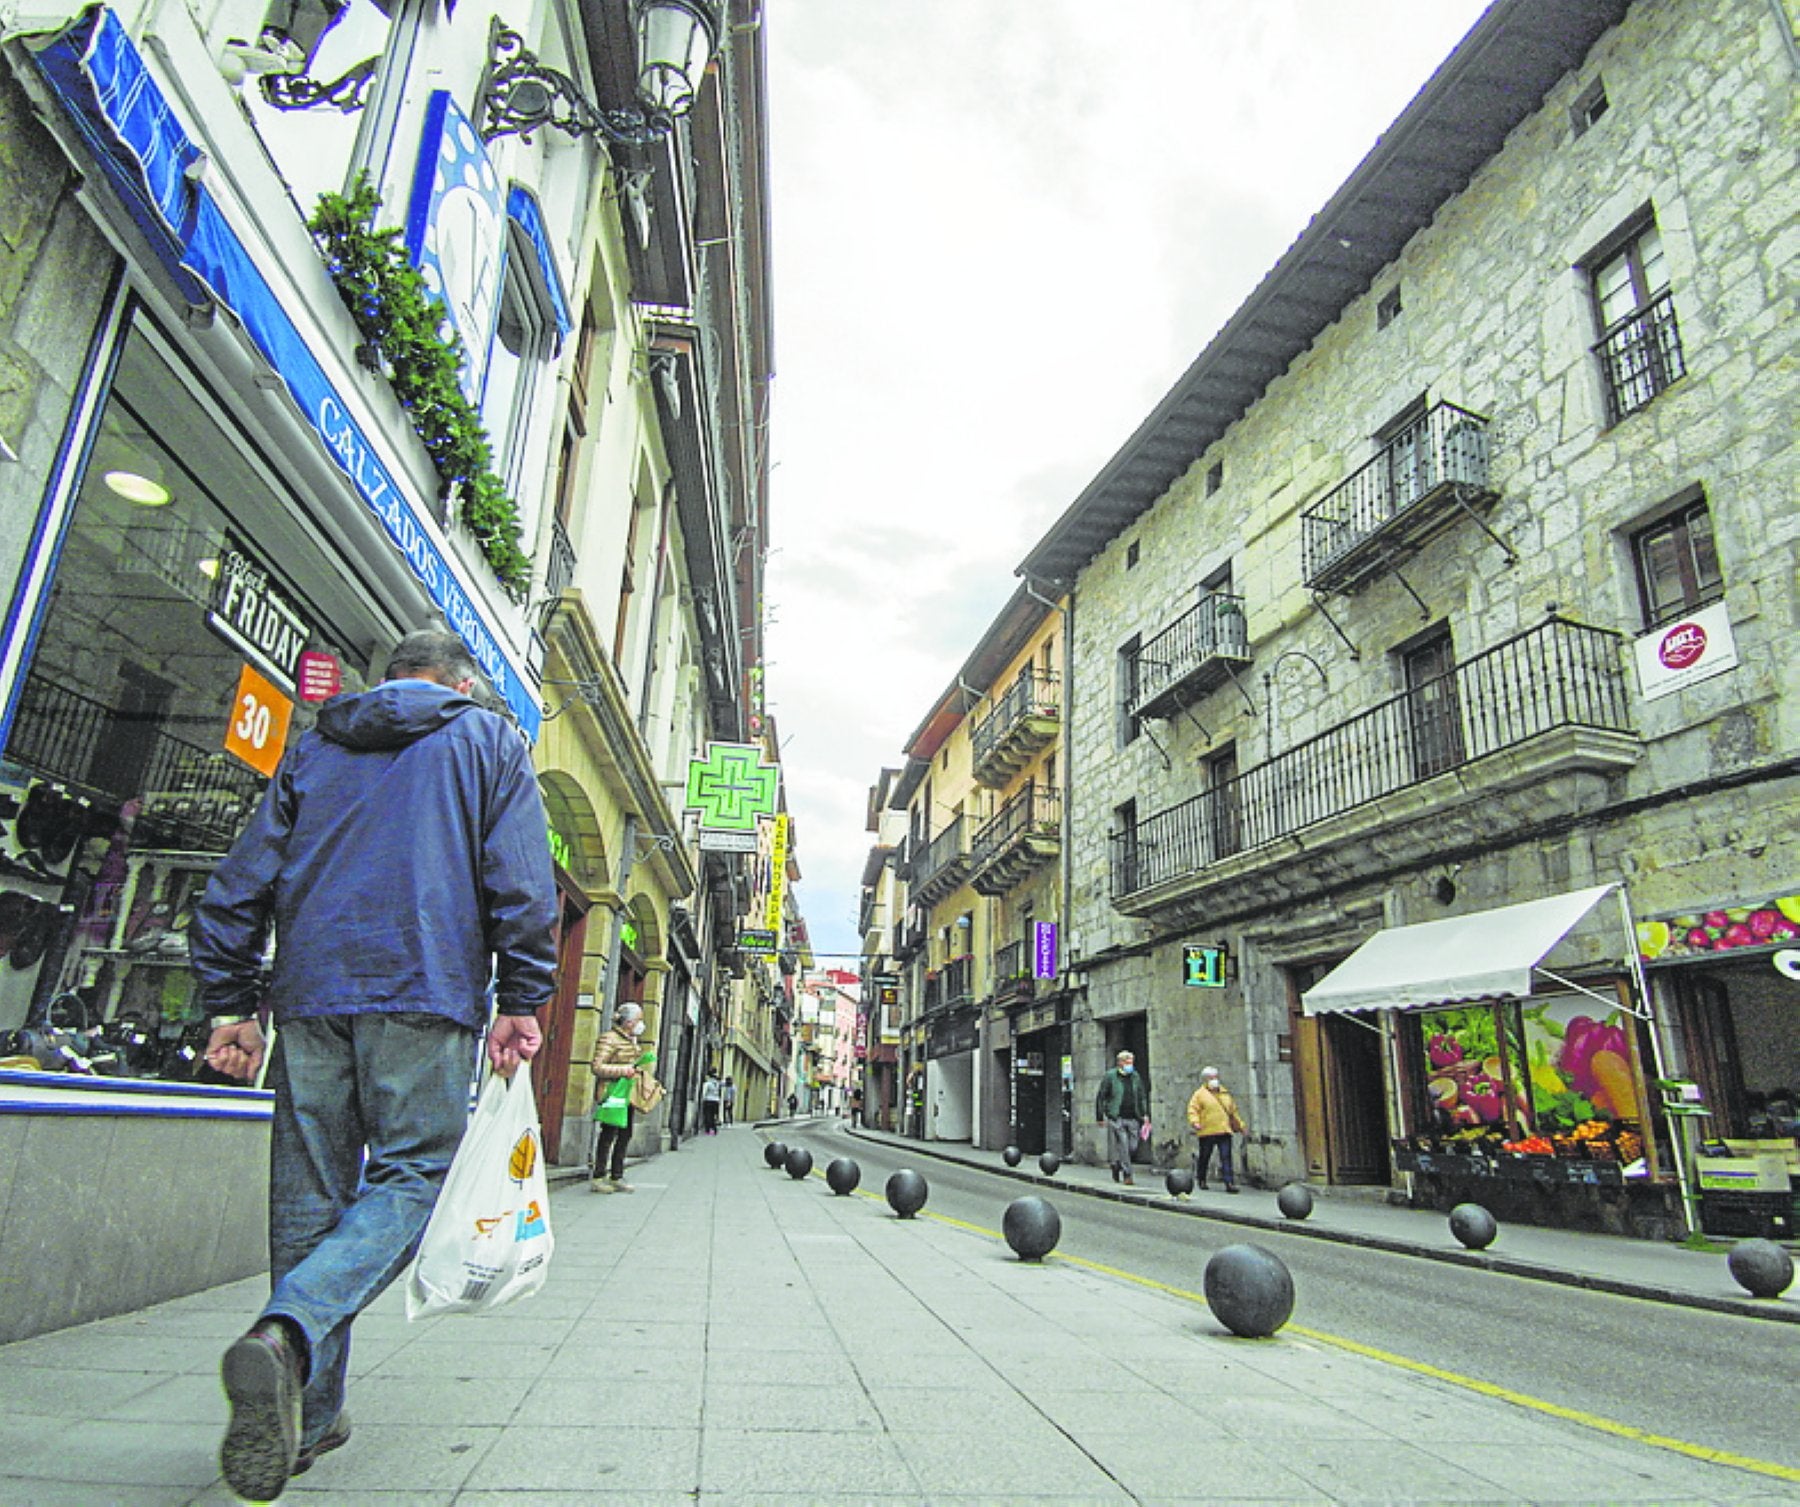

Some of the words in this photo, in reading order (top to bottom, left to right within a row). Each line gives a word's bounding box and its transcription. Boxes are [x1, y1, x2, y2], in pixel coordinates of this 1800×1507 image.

[223, 573, 305, 675] FRIDAY
[320, 397, 439, 589] CALZADOS
[442, 574, 507, 695] VERONICA
